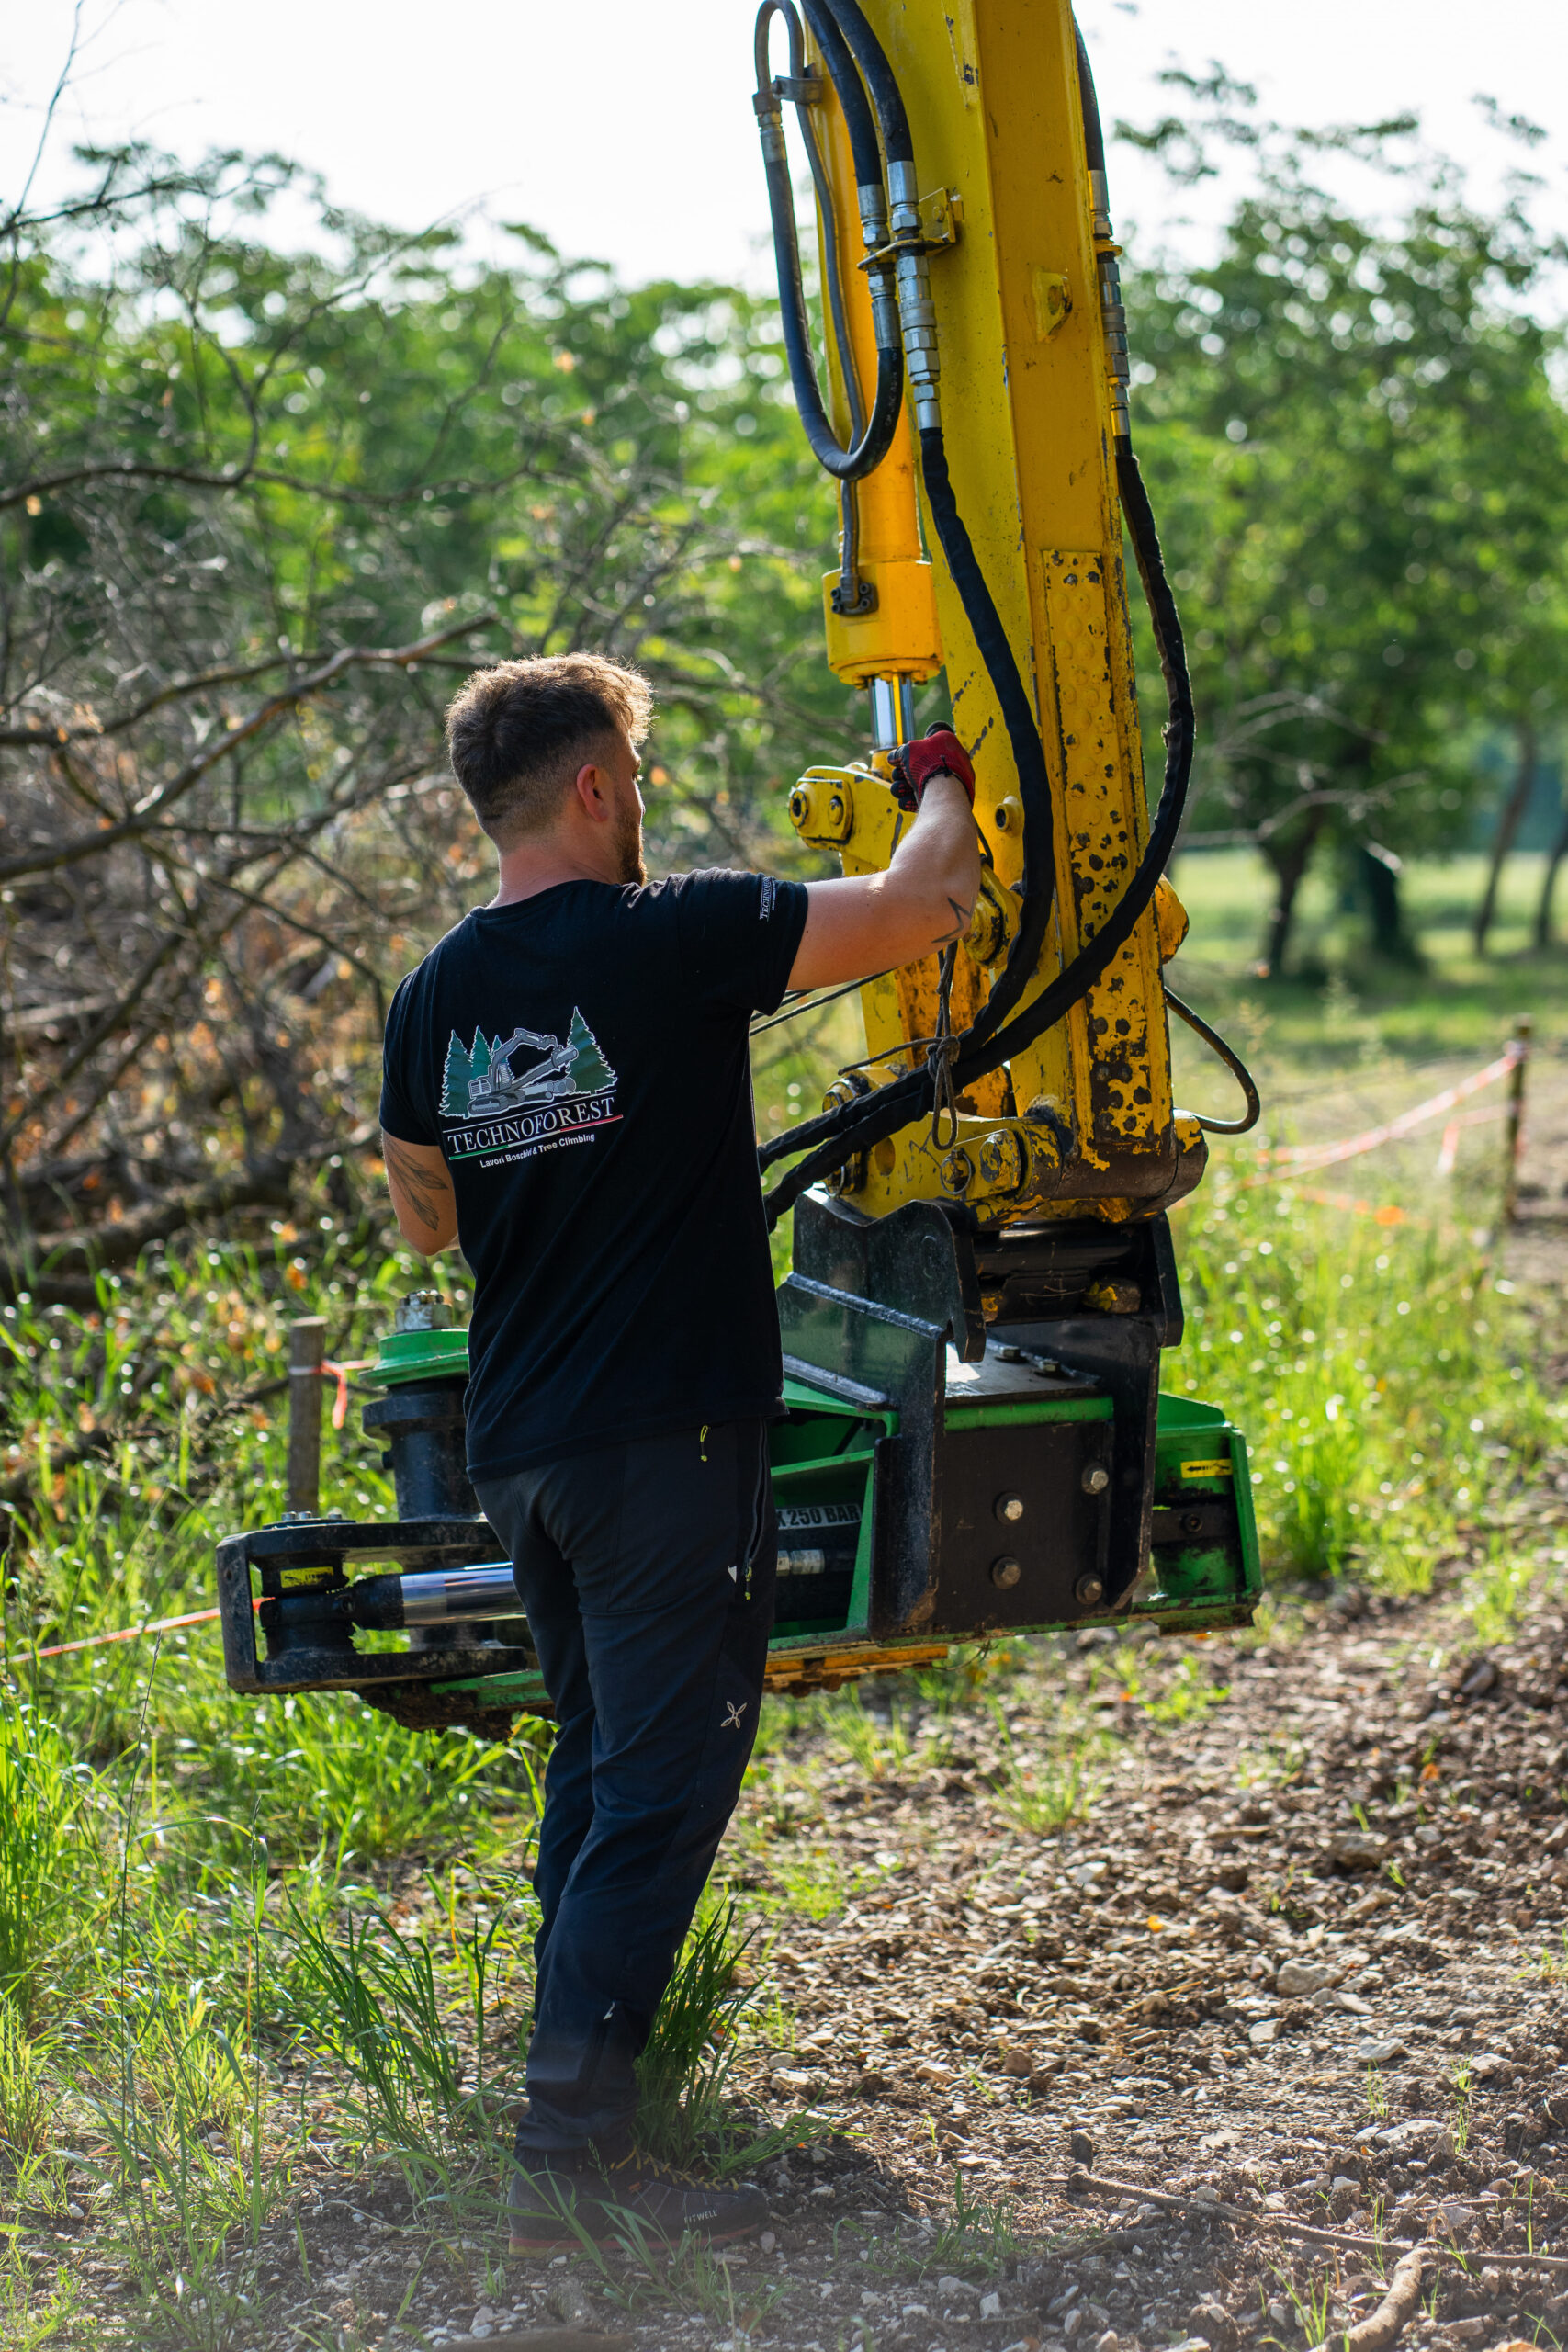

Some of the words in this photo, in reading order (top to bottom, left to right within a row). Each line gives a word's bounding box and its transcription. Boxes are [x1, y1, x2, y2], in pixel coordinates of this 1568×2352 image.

[447, 1096, 615, 1155] TECHNOFOREST
[479, 1156, 504, 1169] Lavori
[532, 1146, 538, 1155] &
[538, 1141, 558, 1153] Tree
[558, 1133, 595, 1147] Climbing
[787, 1508, 822, 1526] 250
[825, 1505, 861, 1523] BAR
[683, 2209, 718, 2224] FITWELL
